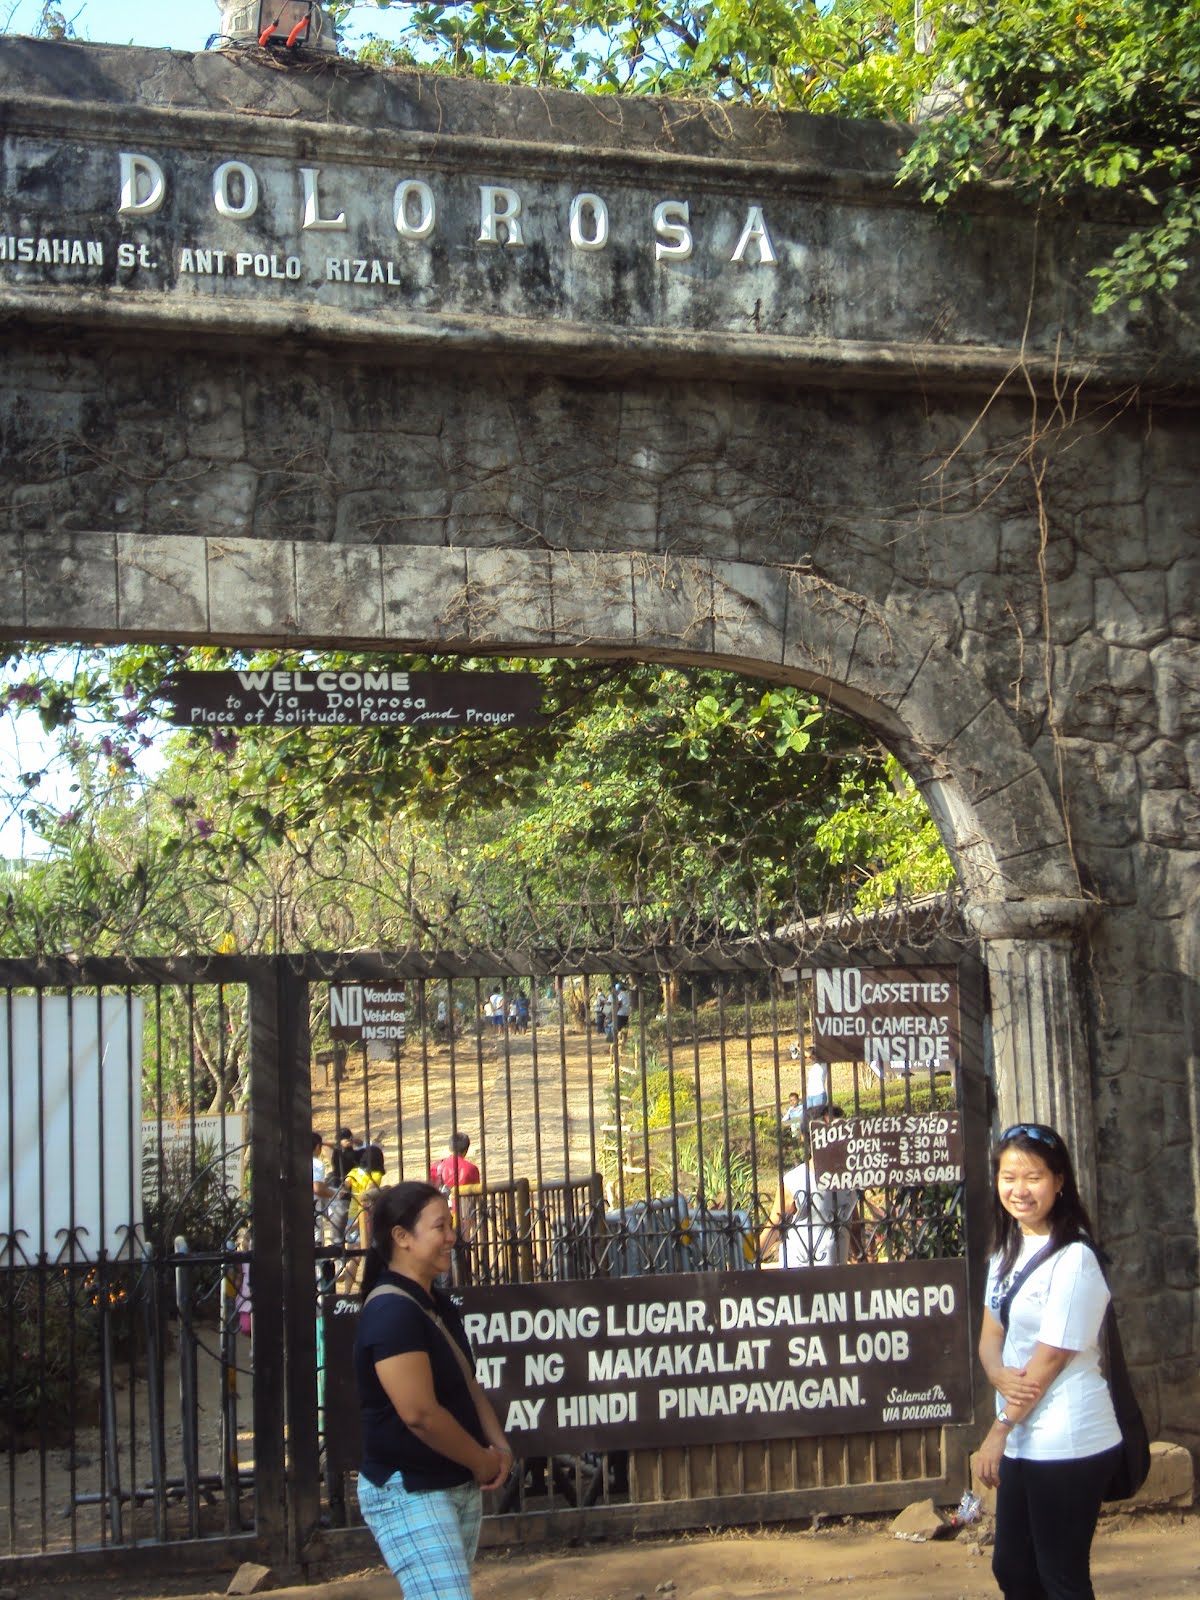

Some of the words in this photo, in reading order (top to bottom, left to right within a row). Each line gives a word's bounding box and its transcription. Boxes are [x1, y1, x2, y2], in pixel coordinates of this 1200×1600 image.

[117, 152, 778, 263] DOLOROSA
[119, 243, 157, 268] St.
[326, 258, 401, 286] RIZAL
[237, 671, 410, 692] WELCOME
[226, 694, 242, 709] to
[258, 693, 299, 708] Via
[326, 693, 426, 709] Dolorosa
[190, 707, 235, 723] Place
[244, 709, 265, 724] of
[360, 708, 406, 722] Peace
[412, 708, 460, 724] and
[466, 709, 515, 726] Prayer
[364, 987, 405, 1003] Vendors
[816, 967, 862, 1014] NO
[861, 982, 950, 1005] CASSETTES
[330, 986, 363, 1027] NO
[363, 1008, 406, 1023] Vehicles
[362, 1026, 405, 1040] INSIDE
[871, 1016, 949, 1036] CAMERAS
[864, 1036, 950, 1063] INSIDE
[813, 1122, 856, 1150] HOLY
[860, 1116, 903, 1138] WEEK
[898, 1136, 931, 1151] 5:30
[933, 1136, 948, 1149] AM
[900, 1152, 931, 1166] 5:30
[933, 1150, 950, 1163] PM
[817, 1170, 886, 1191] SARADO
[923, 1165, 961, 1183] GABI
[461, 1306, 600, 1345] RADONG
[606, 1300, 714, 1336] LUGAR,
[720, 1291, 847, 1331] DASALAN
[854, 1287, 919, 1322] LANG
[923, 1283, 955, 1316] PO
[471, 1356, 507, 1389] AT
[524, 1353, 565, 1386] NG
[588, 1338, 771, 1382] MAKAKALAT
[788, 1335, 828, 1367] SA
[839, 1330, 910, 1365] LOOB
[504, 1398, 546, 1433] AY
[556, 1391, 638, 1428] HINDI
[658, 1375, 867, 1420] PINAPAYAGAN.
[886, 1387, 932, 1404] Salamat
[882, 1407, 901, 1423] VIA
[901, 1402, 953, 1421] DOLOROSA
